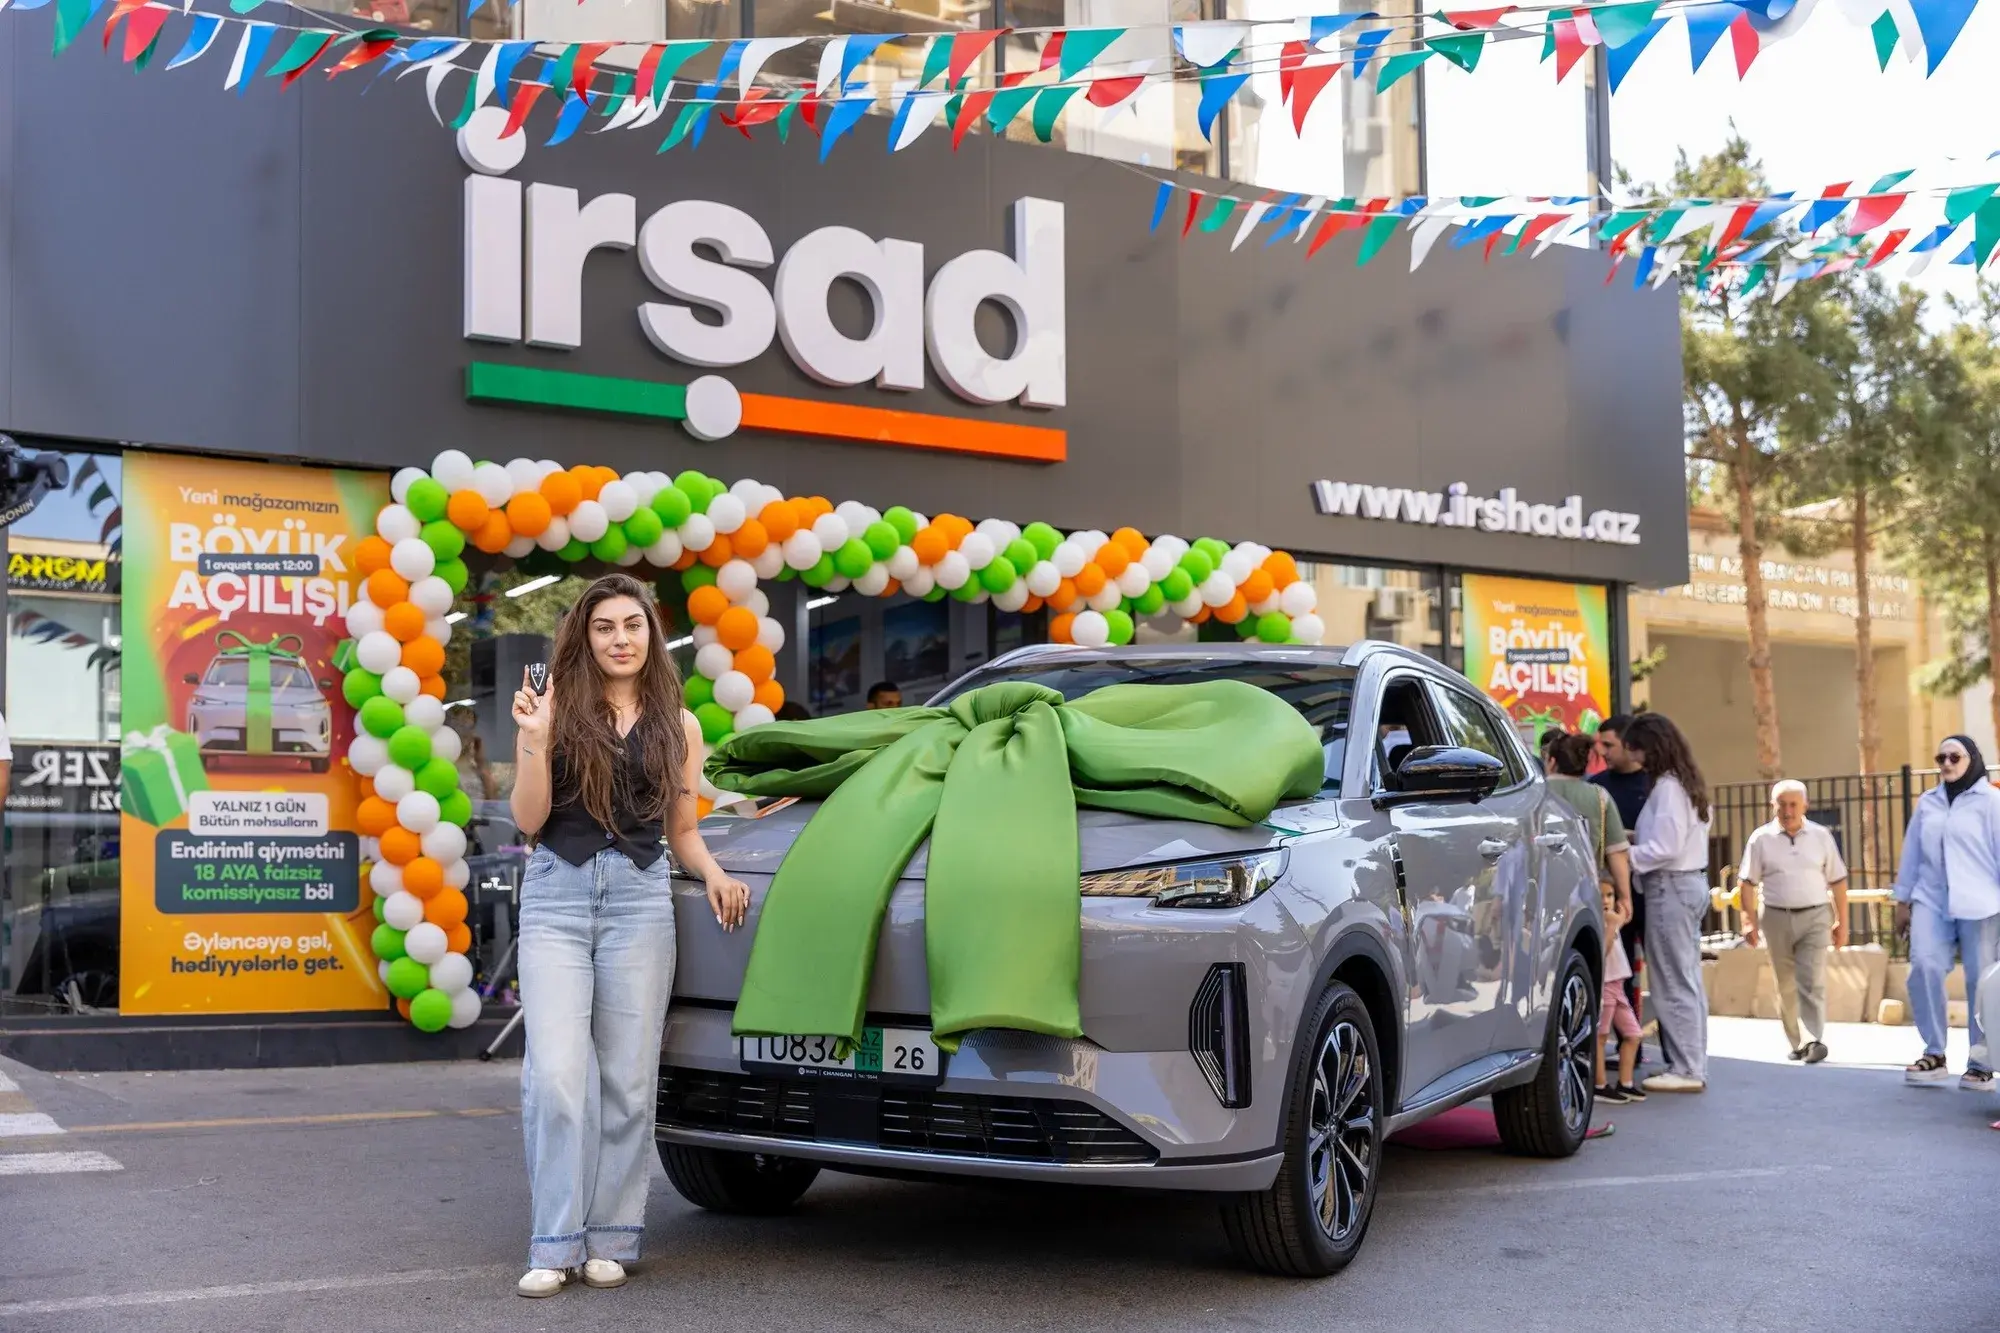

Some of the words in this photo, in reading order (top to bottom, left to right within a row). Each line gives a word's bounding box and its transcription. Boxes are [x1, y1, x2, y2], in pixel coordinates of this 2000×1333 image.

[0, 498, 35, 525] RONIN
[178, 486, 218, 505] Yeni
[223, 493, 340, 515] mağazamızın
[1313, 479, 1641, 545] www.irshad.az
[169, 513, 349, 573] BÖYÜK
[204, 559, 211, 571] 1
[213, 561, 253, 573] avqust
[254, 561, 281, 571] saat
[282, 559, 314, 571] 12:00
[167, 569, 350, 627] AÇILIŞI
[1488, 618, 1587, 662] BÖYÜK
[1489, 661, 1589, 701] AÇILIŞI
[212, 800, 262, 813] YALNIZ
[266, 802, 271, 812] 1
[274, 799, 306, 813] GÜN
[199, 815, 240, 827] Bütün
[243, 816, 318, 828] məhsulların
[171, 841, 254, 859] Endirimli
[258, 842, 345, 863] qiymətini
[194, 864, 216, 881] 18
[220, 864, 259, 880] AYA
[263, 863, 323, 881] faizsiz
[182, 883, 300, 904] komissiyasız
[304, 883, 334, 901] böl
[183, 932, 293, 955] Əyləncəyə
[297, 931, 332, 953] gəl,
[171, 955, 298, 976] hədiyyələrlə
[304, 955, 344, 975] get.
[860, 1052, 879, 1067] TR
[893, 1045, 925, 1070] 26
[822, 1070, 853, 1078] CHANGAN
